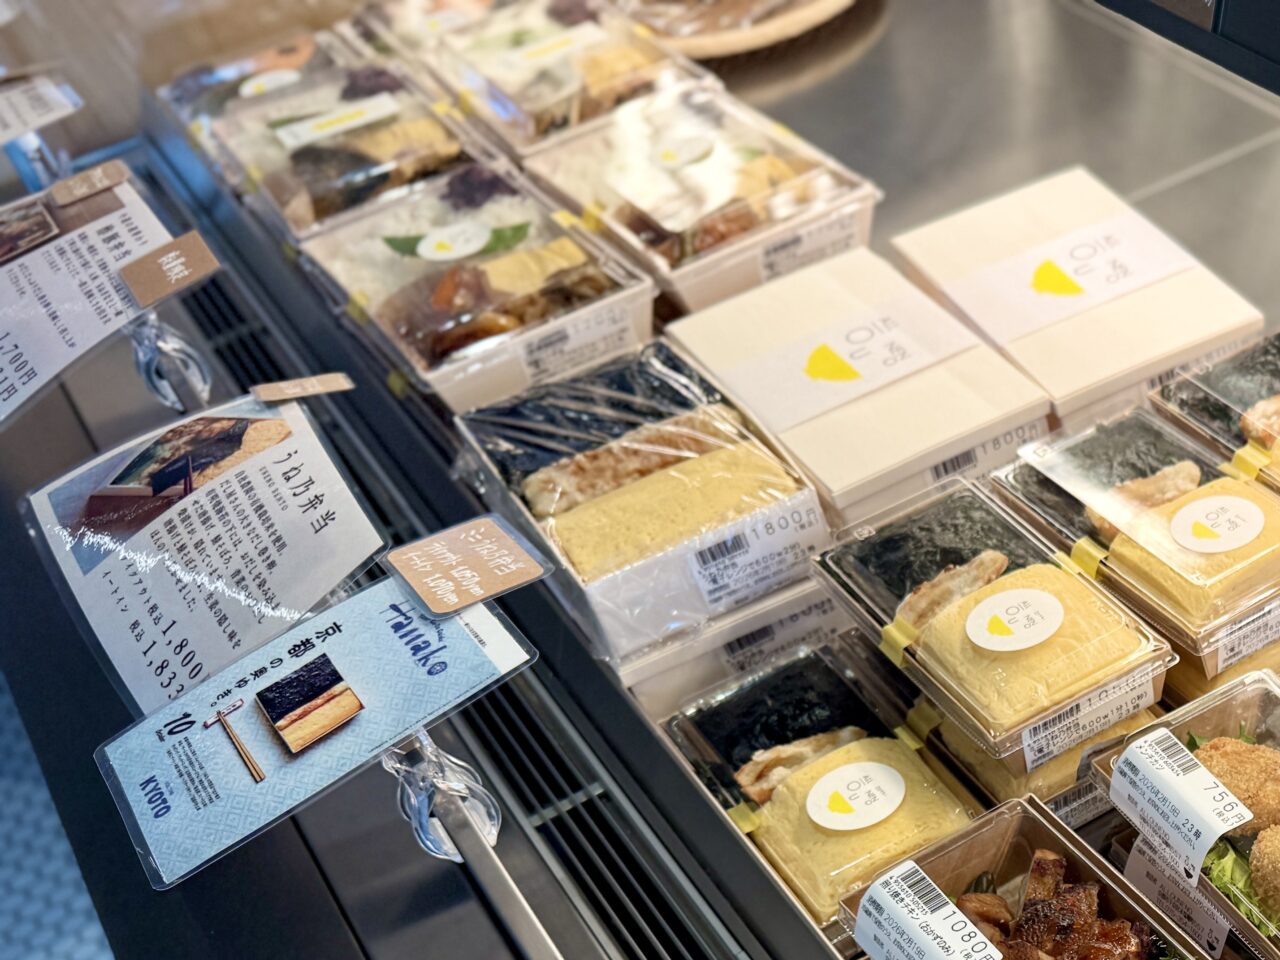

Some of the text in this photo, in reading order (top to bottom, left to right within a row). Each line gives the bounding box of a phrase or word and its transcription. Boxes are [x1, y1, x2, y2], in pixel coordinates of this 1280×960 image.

[270, 447, 340, 536] うね乃弁当
[158, 619, 206, 684] 1,800
[161, 709, 197, 739] 10
[135, 774, 176, 820] KYOTO
[1202, 778, 1245, 825] 756円
[1179, 817, 1203, 841] 23時
[878, 877, 922, 921] 照り焼きチキン
[882, 913, 927, 960] 2026年2月19日
